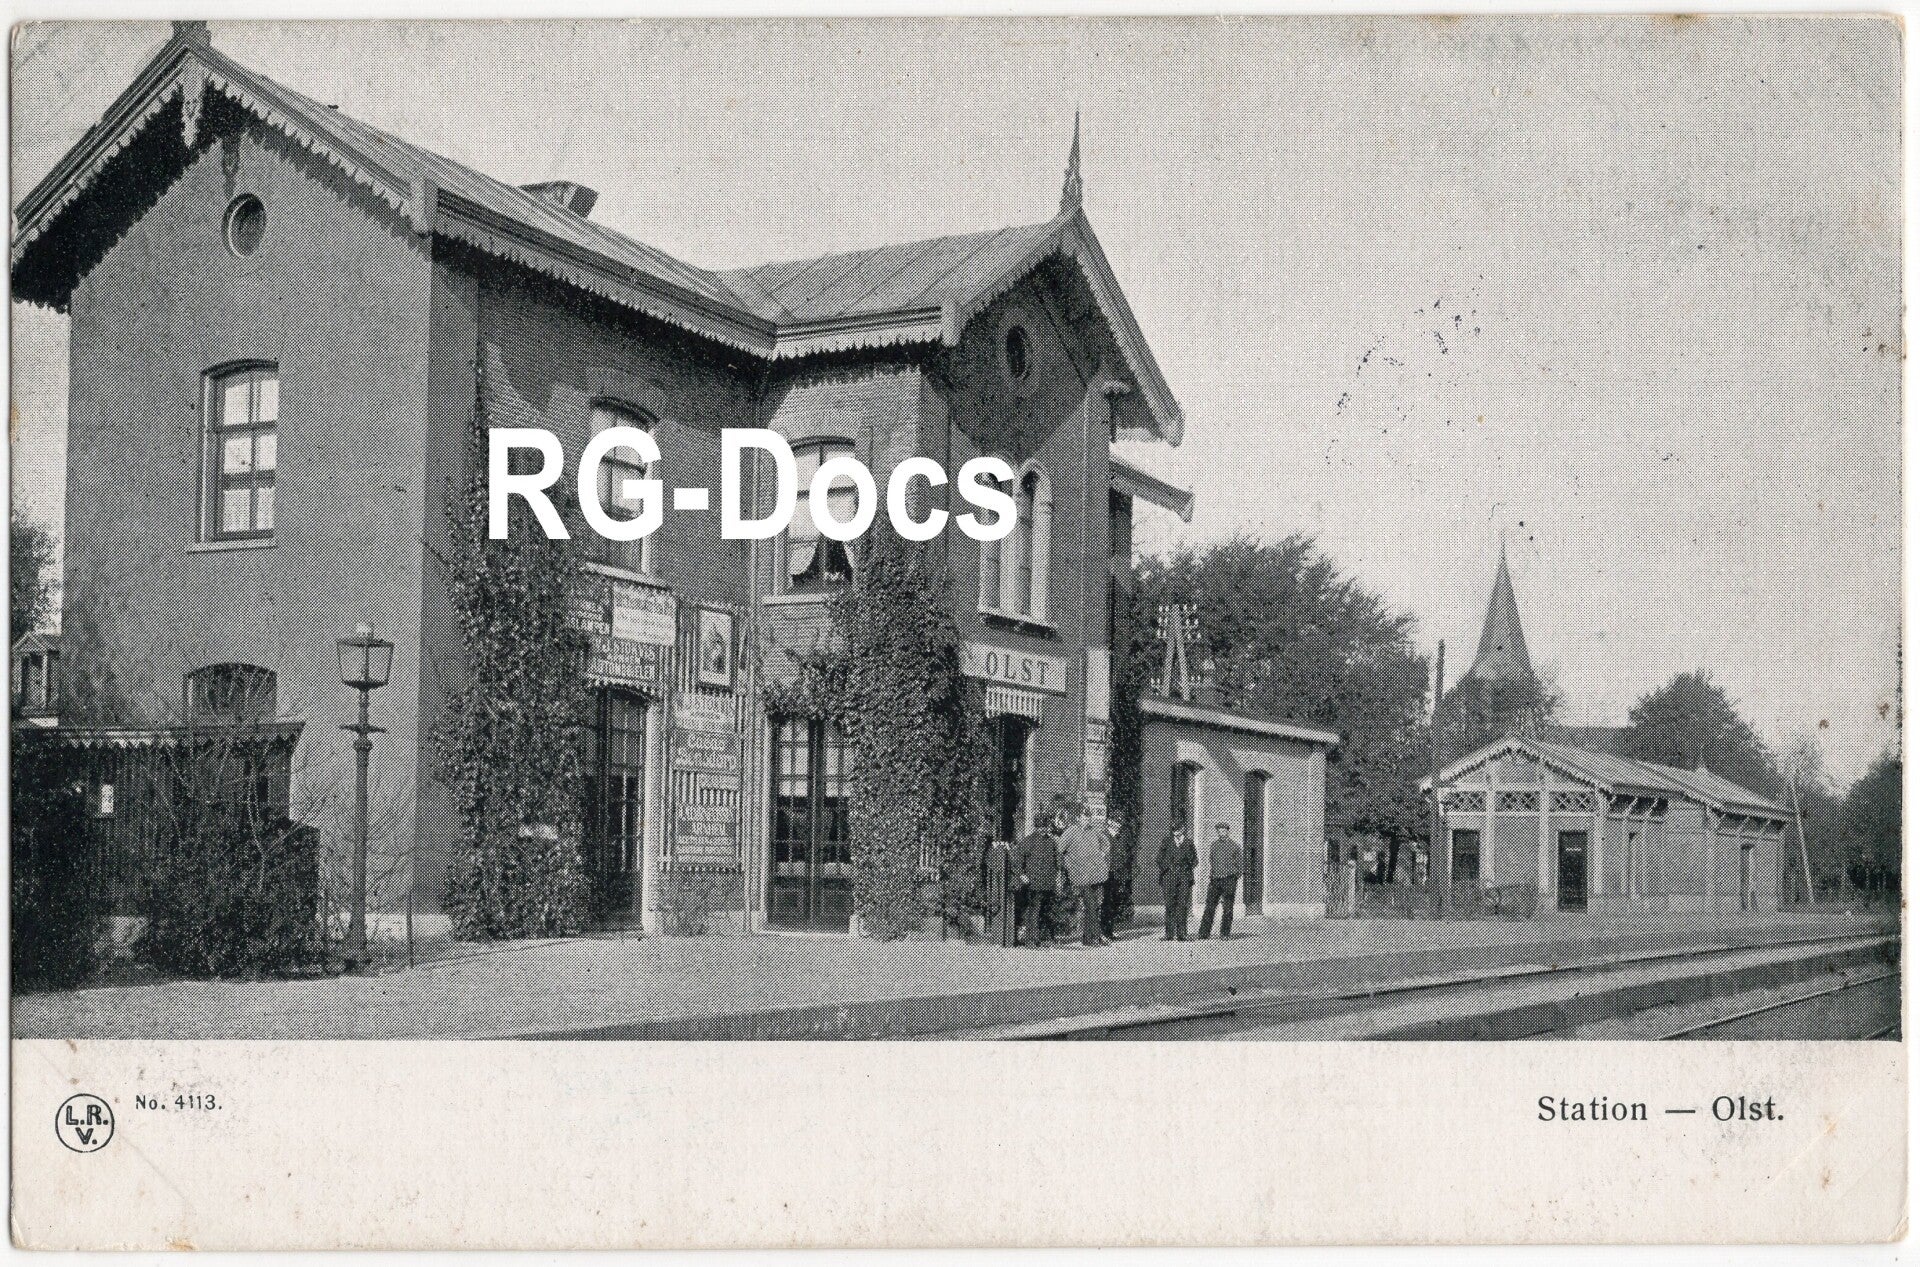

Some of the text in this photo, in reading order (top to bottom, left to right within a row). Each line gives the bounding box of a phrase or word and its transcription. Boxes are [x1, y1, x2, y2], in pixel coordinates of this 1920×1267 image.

[986, 651, 1048, 684] OLST
[135, 1094, 223, 1110] No. 4113.
[1537, 1095, 1648, 1121] Station
[1712, 1095, 1784, 1121] Olst.
[74, 1127, 98, 1144] V.
